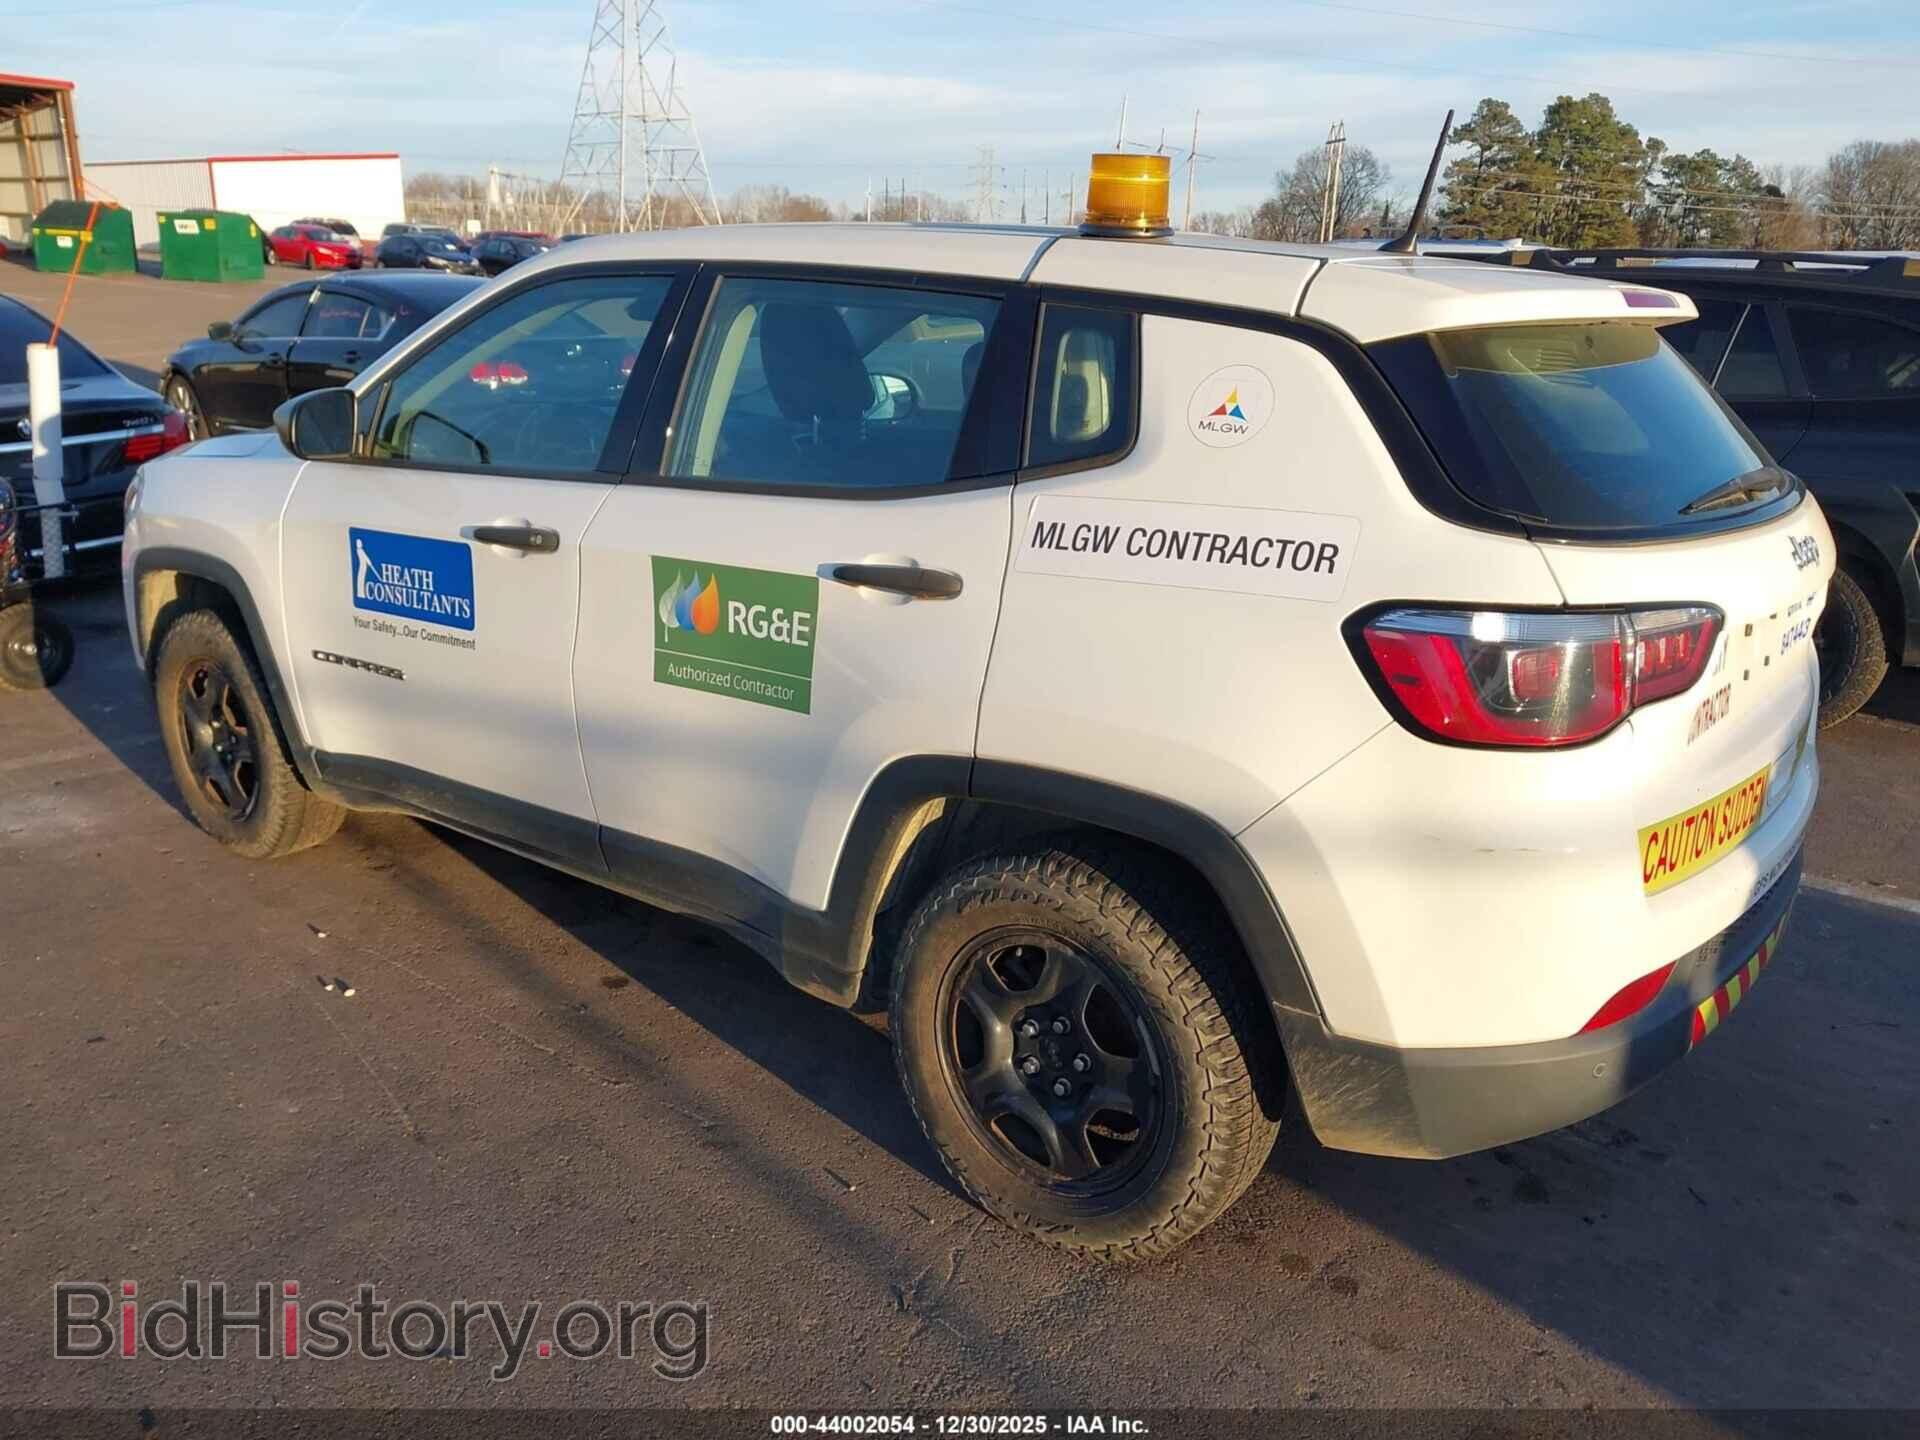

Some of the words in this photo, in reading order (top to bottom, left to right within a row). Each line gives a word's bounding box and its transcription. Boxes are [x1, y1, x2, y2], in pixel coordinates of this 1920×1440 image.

[1198, 420, 1249, 436] MLGW
[1031, 521, 1121, 555] MLGW
[1126, 526, 1340, 574] CONTRACTOR
[381, 563, 434, 591] HEATH
[366, 581, 471, 619] CONSULTANTS
[353, 616, 371, 629] Your
[420, 628, 476, 650] Commitment
[728, 600, 812, 647] RG&E
[312, 649, 405, 681] COMPASS
[667, 663, 731, 689] Authorized
[733, 675, 796, 701] Contractor
[1643, 801, 1721, 884] CAUTION
